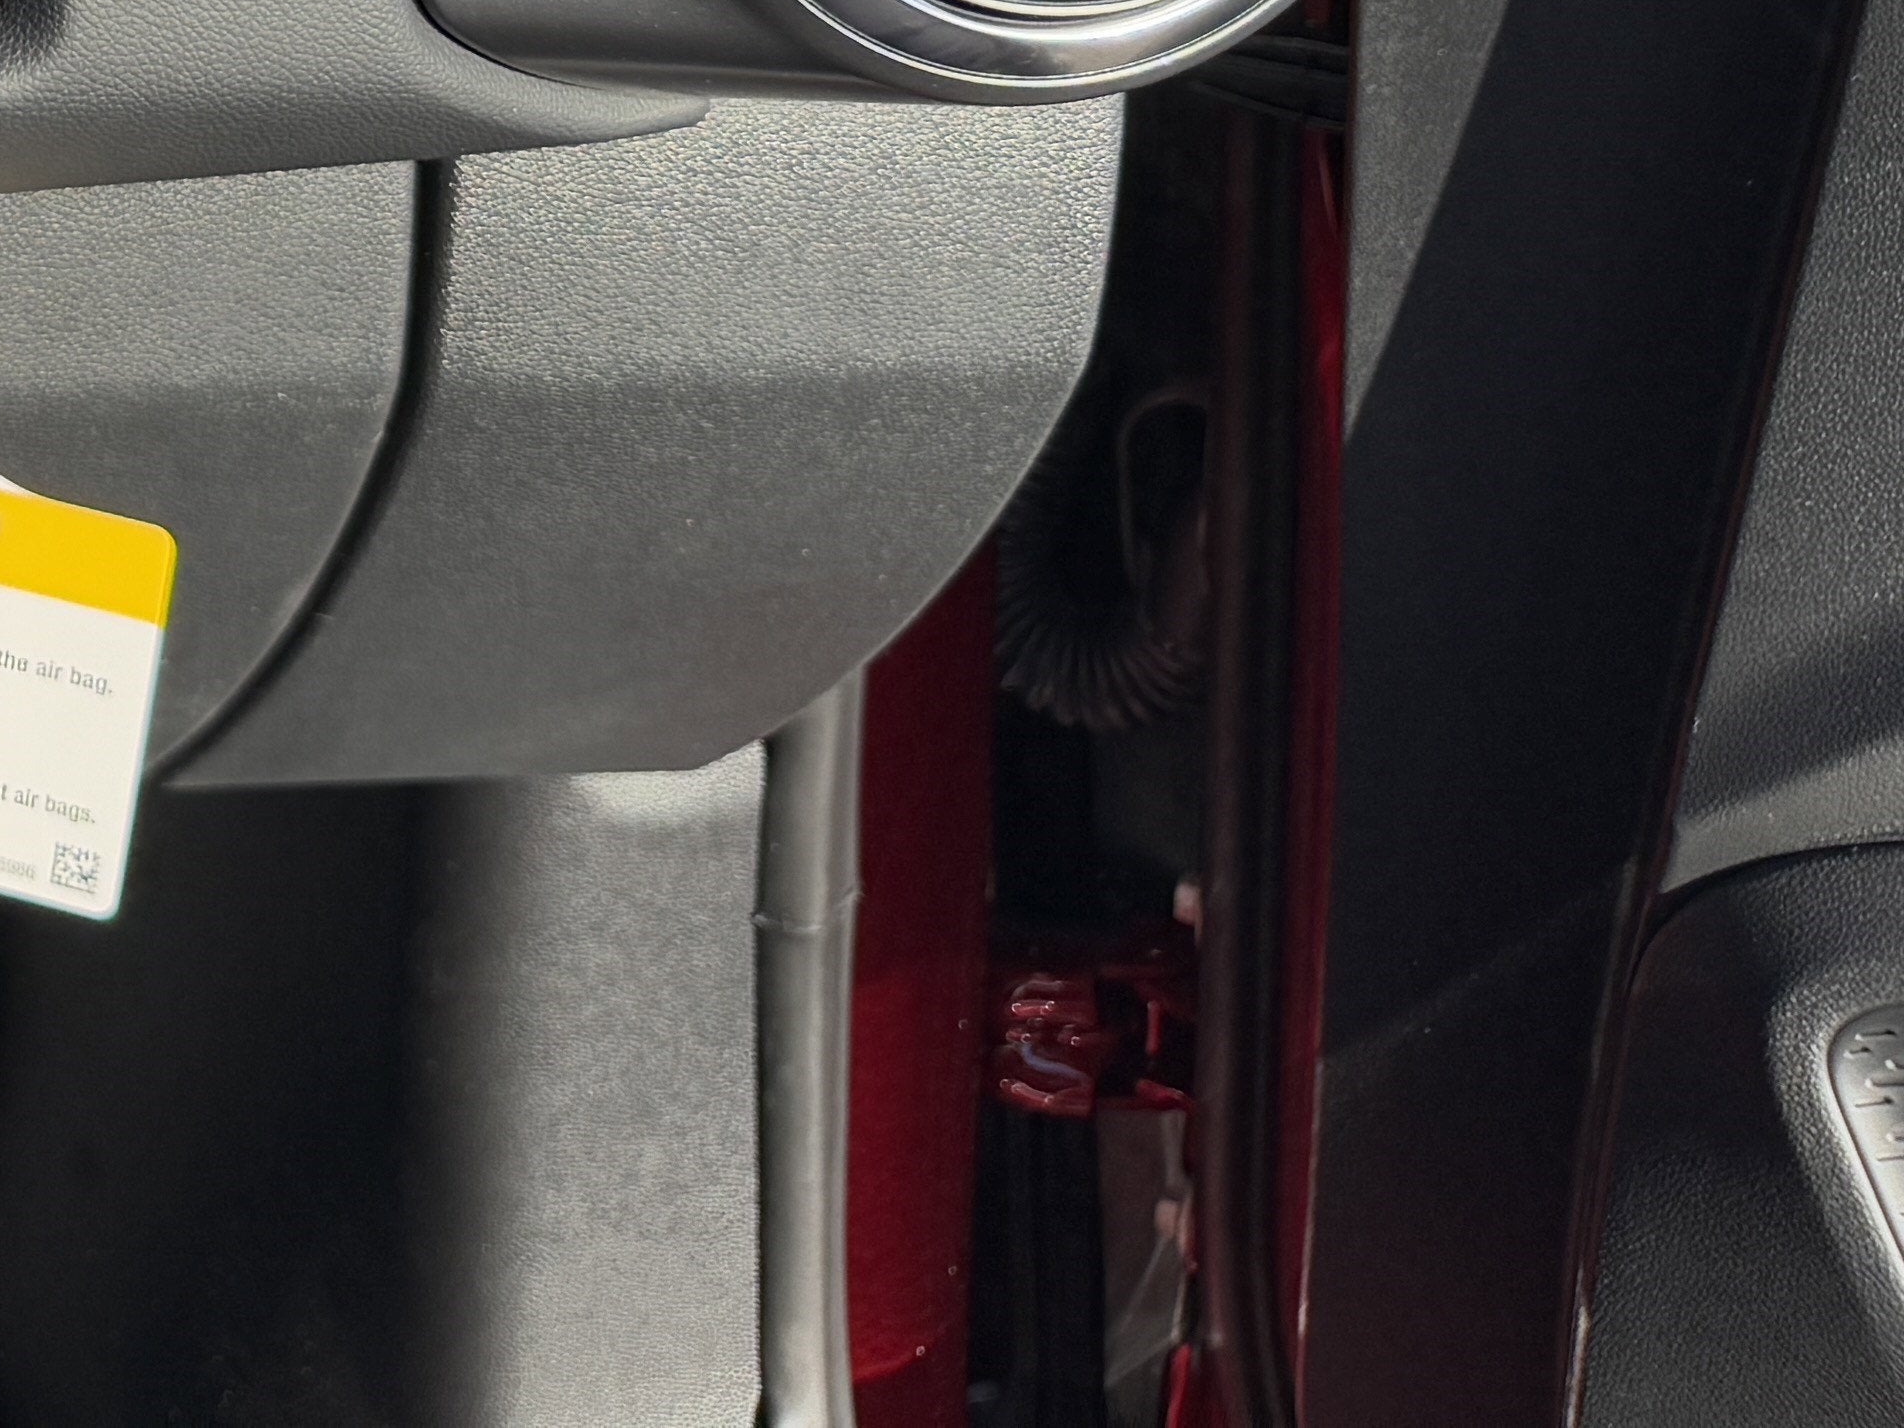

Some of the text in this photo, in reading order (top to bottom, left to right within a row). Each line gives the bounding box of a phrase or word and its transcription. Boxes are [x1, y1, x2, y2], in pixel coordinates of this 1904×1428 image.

[35, 659, 65, 683] air
[68, 665, 114, 697] bag.
[12, 787, 41, 810] air
[43, 793, 97, 825] bags.
